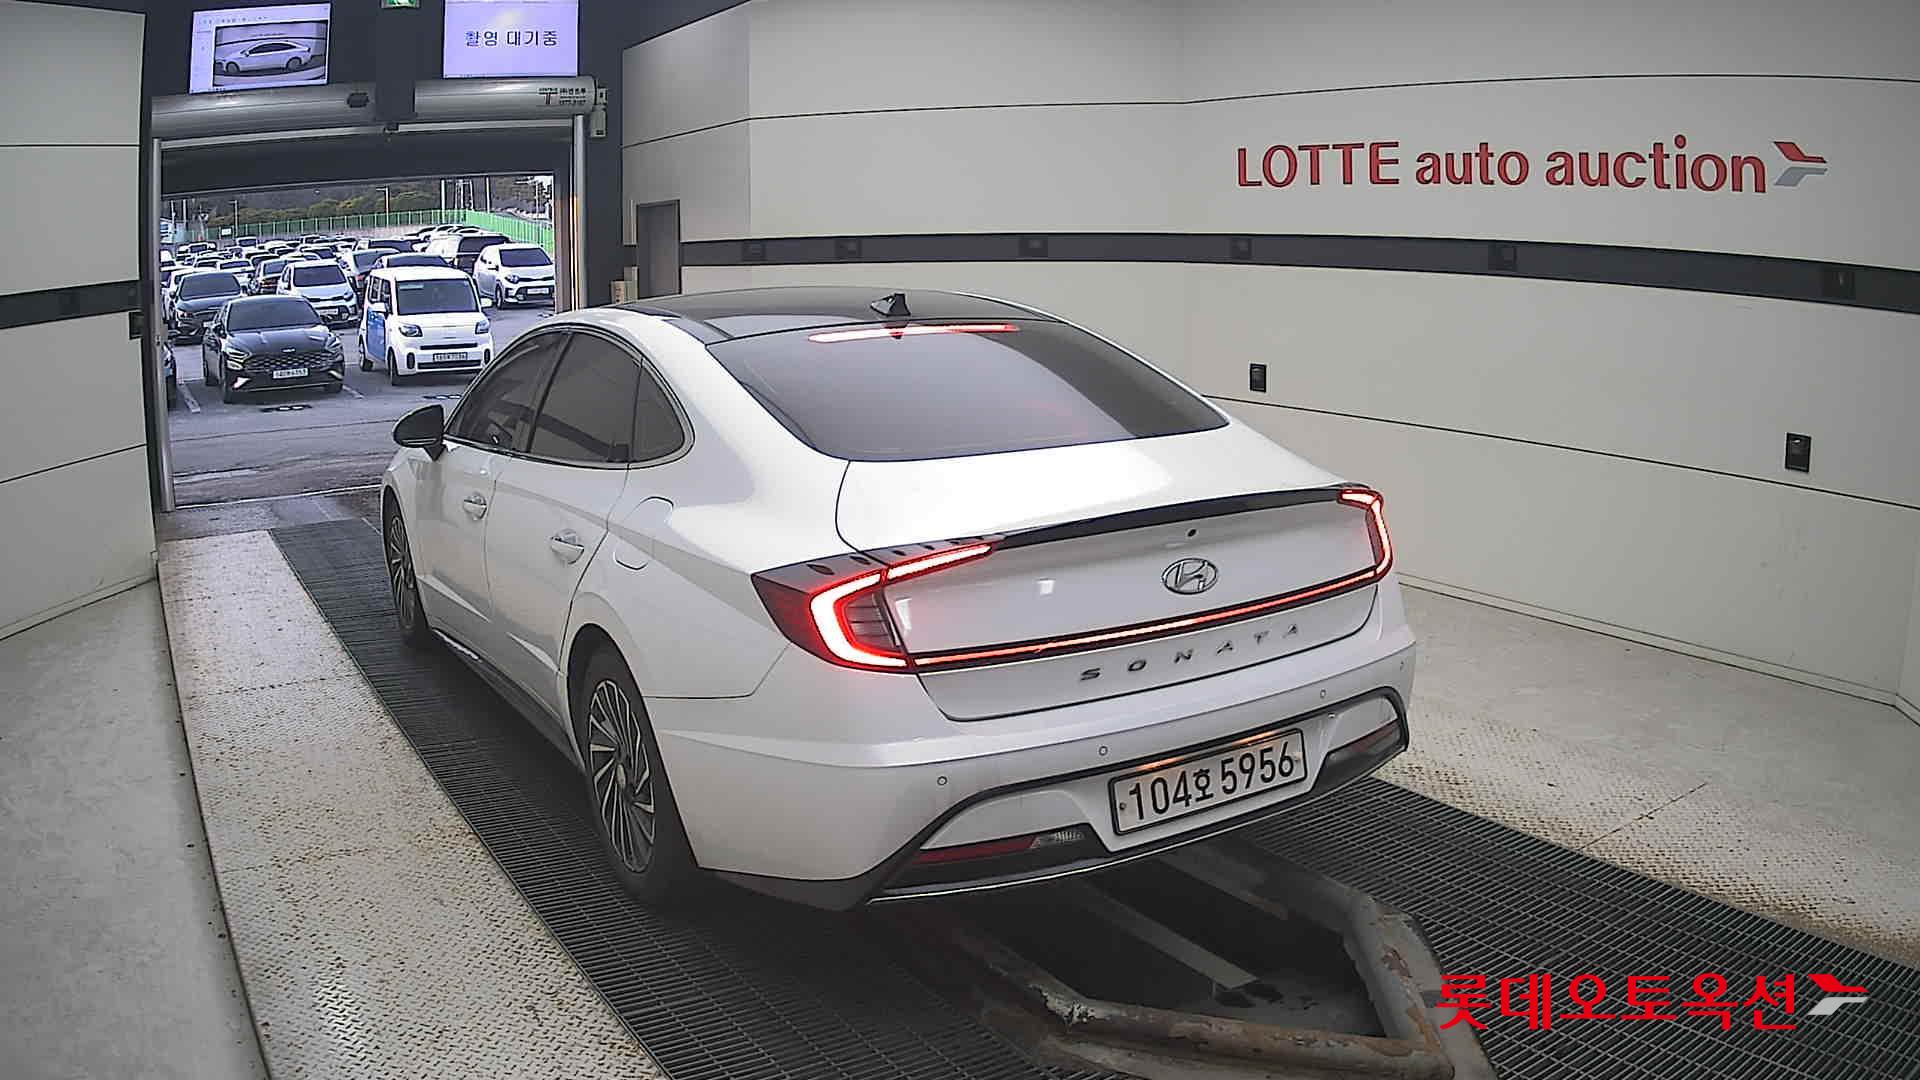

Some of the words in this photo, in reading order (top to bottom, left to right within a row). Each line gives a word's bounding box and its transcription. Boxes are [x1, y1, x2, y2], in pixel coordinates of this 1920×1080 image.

[507, 30, 558, 47] 대기중
[1237, 140, 1400, 187] LOTTE
[1415, 142, 1529, 188] auto
[1545, 134, 1767, 194] auction
[1079, 624, 1299, 682] SONATA
